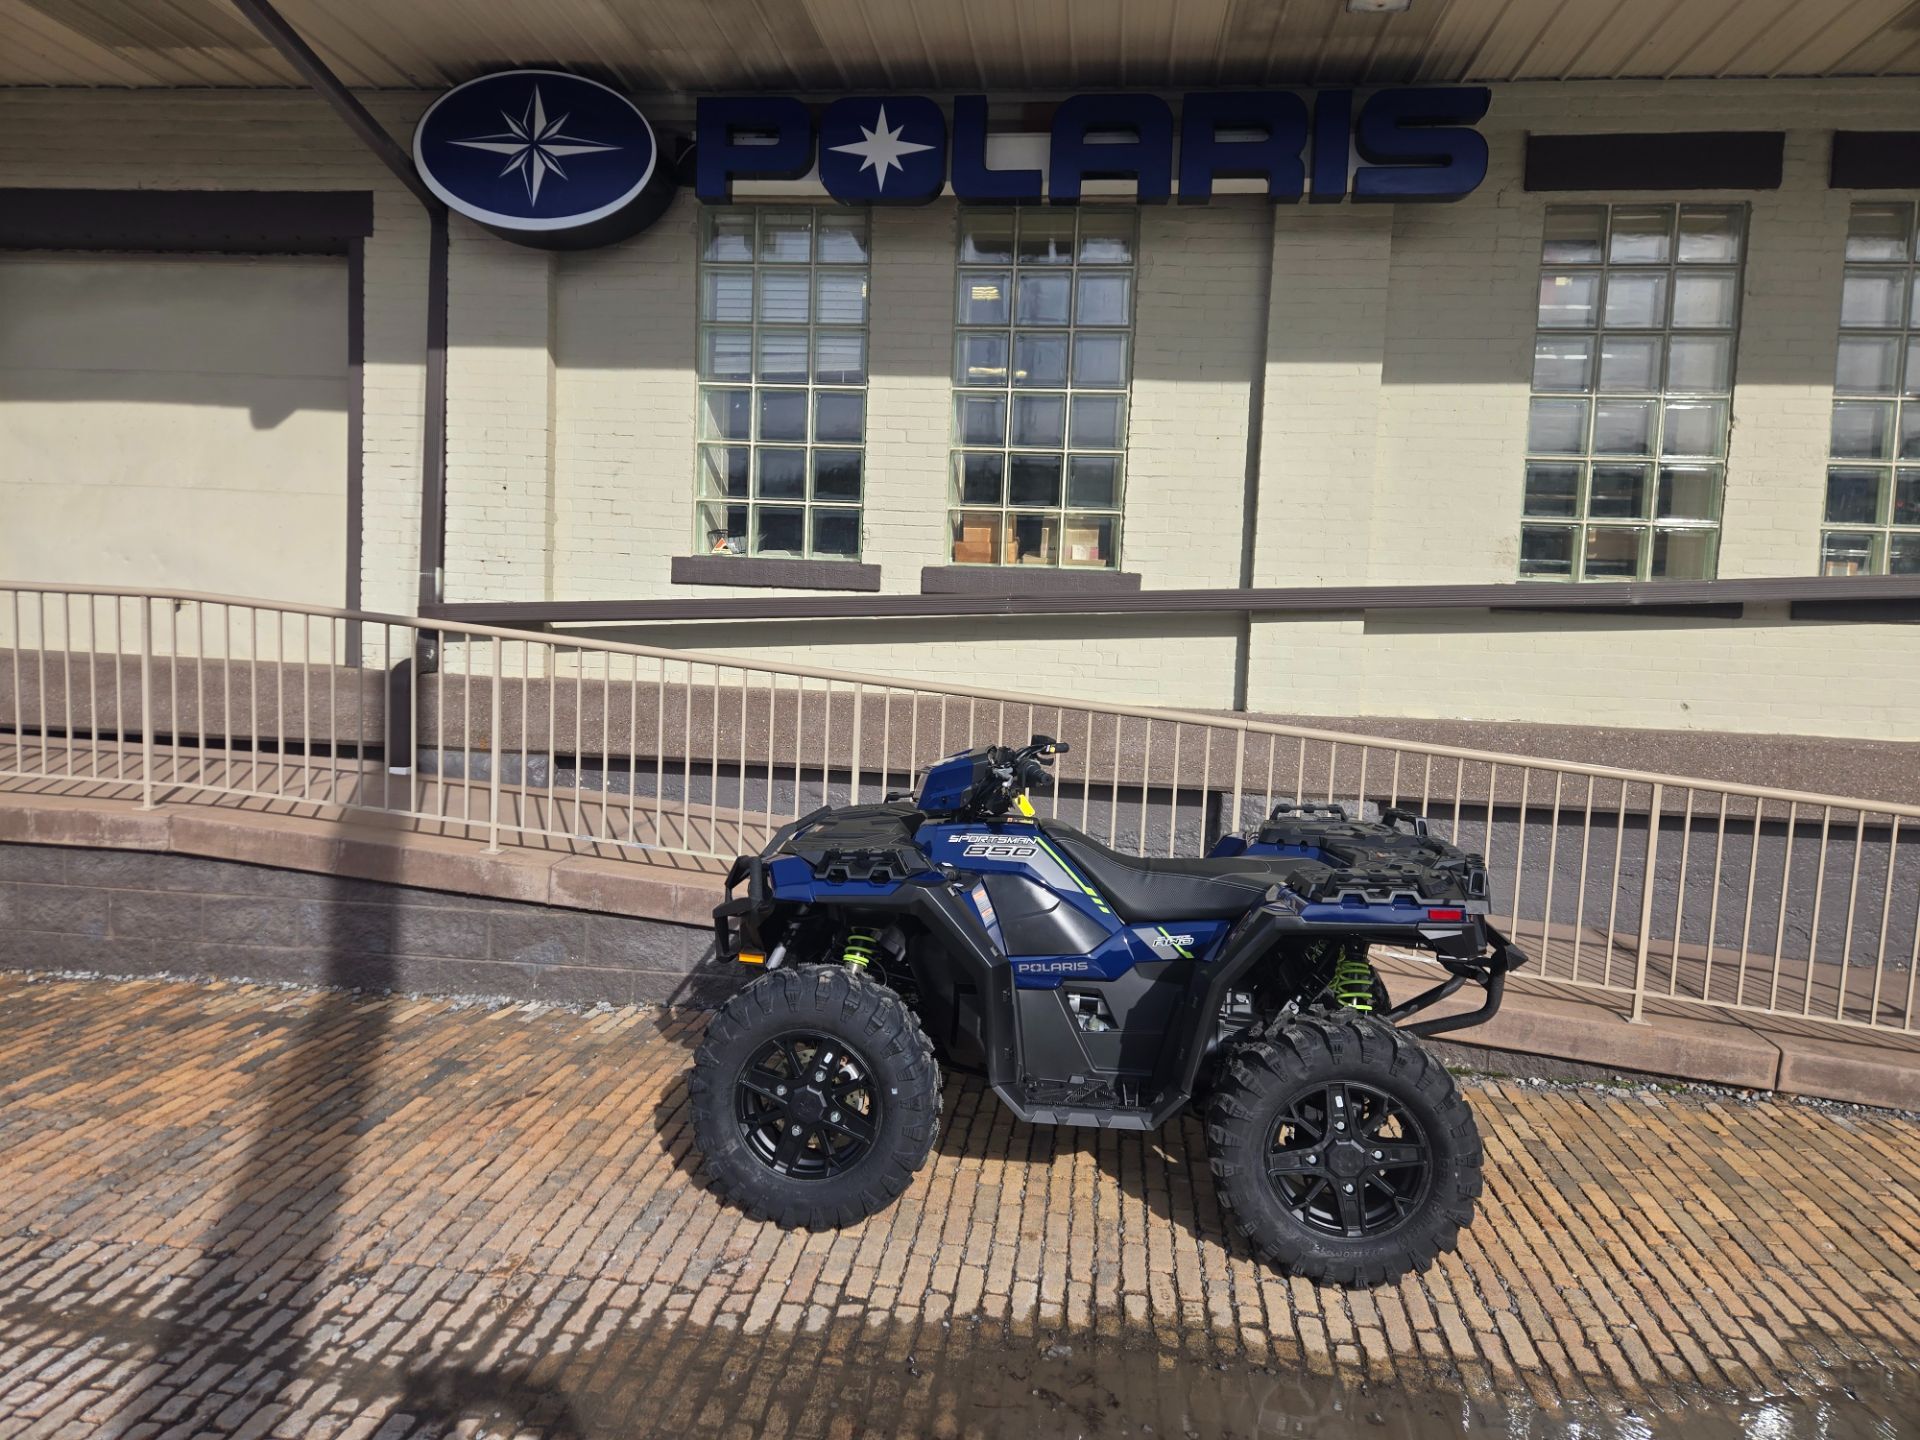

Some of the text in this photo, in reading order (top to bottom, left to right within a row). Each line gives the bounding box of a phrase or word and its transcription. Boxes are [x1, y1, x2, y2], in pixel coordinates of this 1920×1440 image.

[696, 87, 1491, 206] POLARIS
[948, 834, 1037, 845] SPORTSMAN
[963, 845, 1039, 858] 850
[1018, 962, 1089, 973] POLARIS
